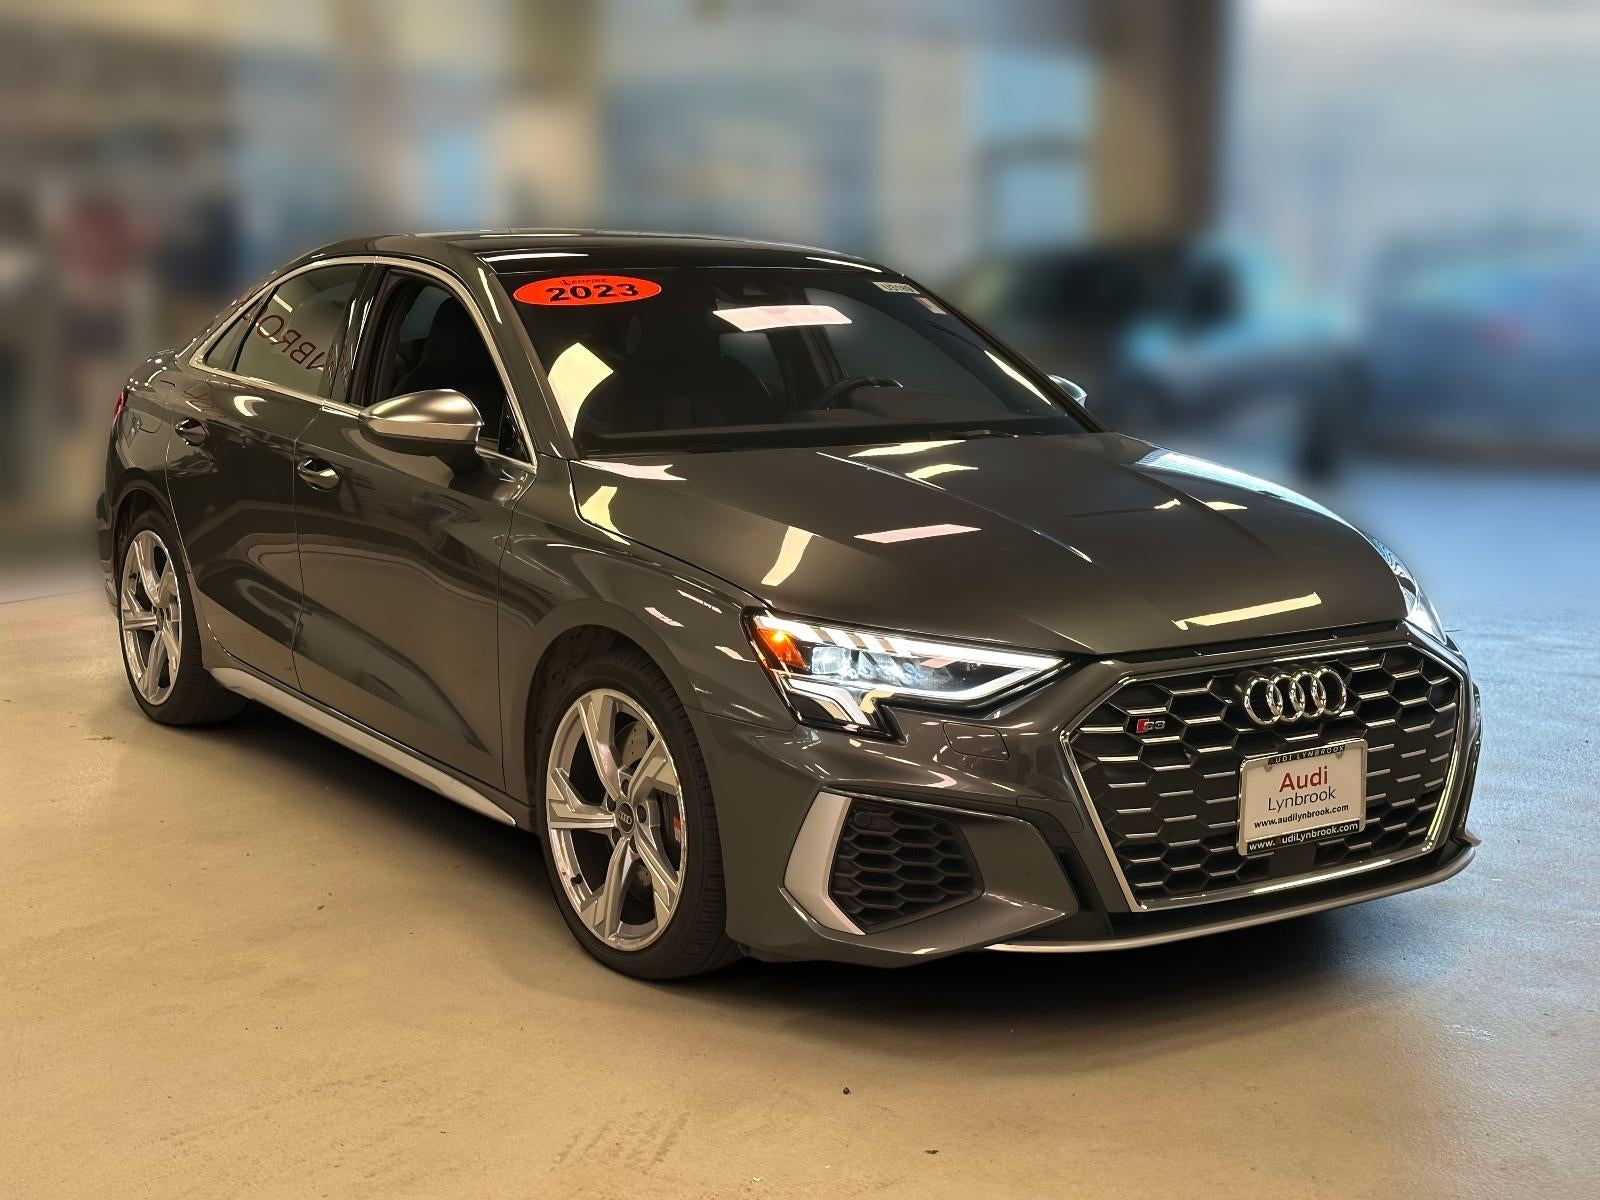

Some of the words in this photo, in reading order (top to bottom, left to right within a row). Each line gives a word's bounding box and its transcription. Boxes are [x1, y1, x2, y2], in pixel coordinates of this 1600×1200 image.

[545, 283, 639, 302] 2023
[1296, 745, 1345, 760] LYNBROOK
[1279, 765, 1328, 792] Audi
[1268, 786, 1337, 813] Lynbrook
[1254, 804, 1349, 828] www.audilynbrook.com
